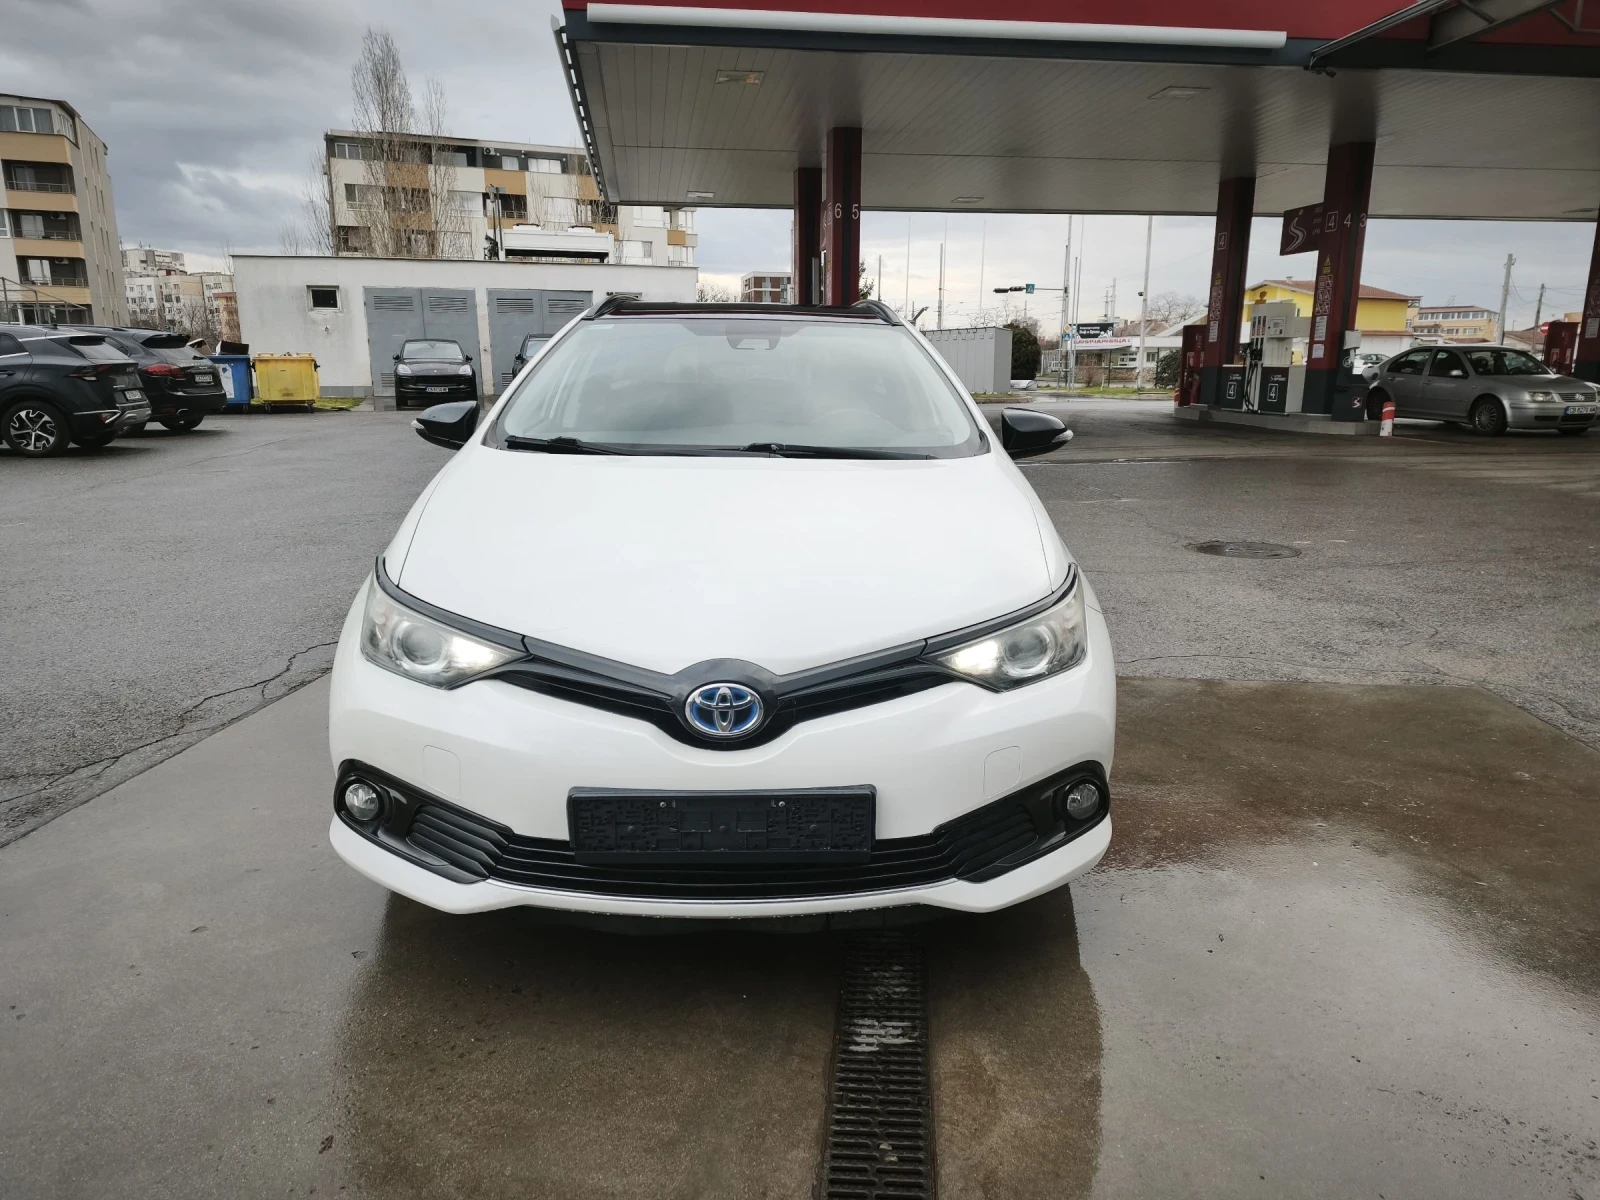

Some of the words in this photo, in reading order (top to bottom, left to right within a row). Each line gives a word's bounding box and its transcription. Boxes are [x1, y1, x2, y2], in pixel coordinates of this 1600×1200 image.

[834, 203, 842, 218] 6
[852, 204, 859, 219] 5
[1328, 214, 1335, 228] 4
[1343, 212, 1352, 228] 4
[1359, 212, 1367, 228] 3
[1219, 234, 1225, 247] 4
[1228, 384, 1235, 397] 4
[1269, 386, 1276, 399] 4
